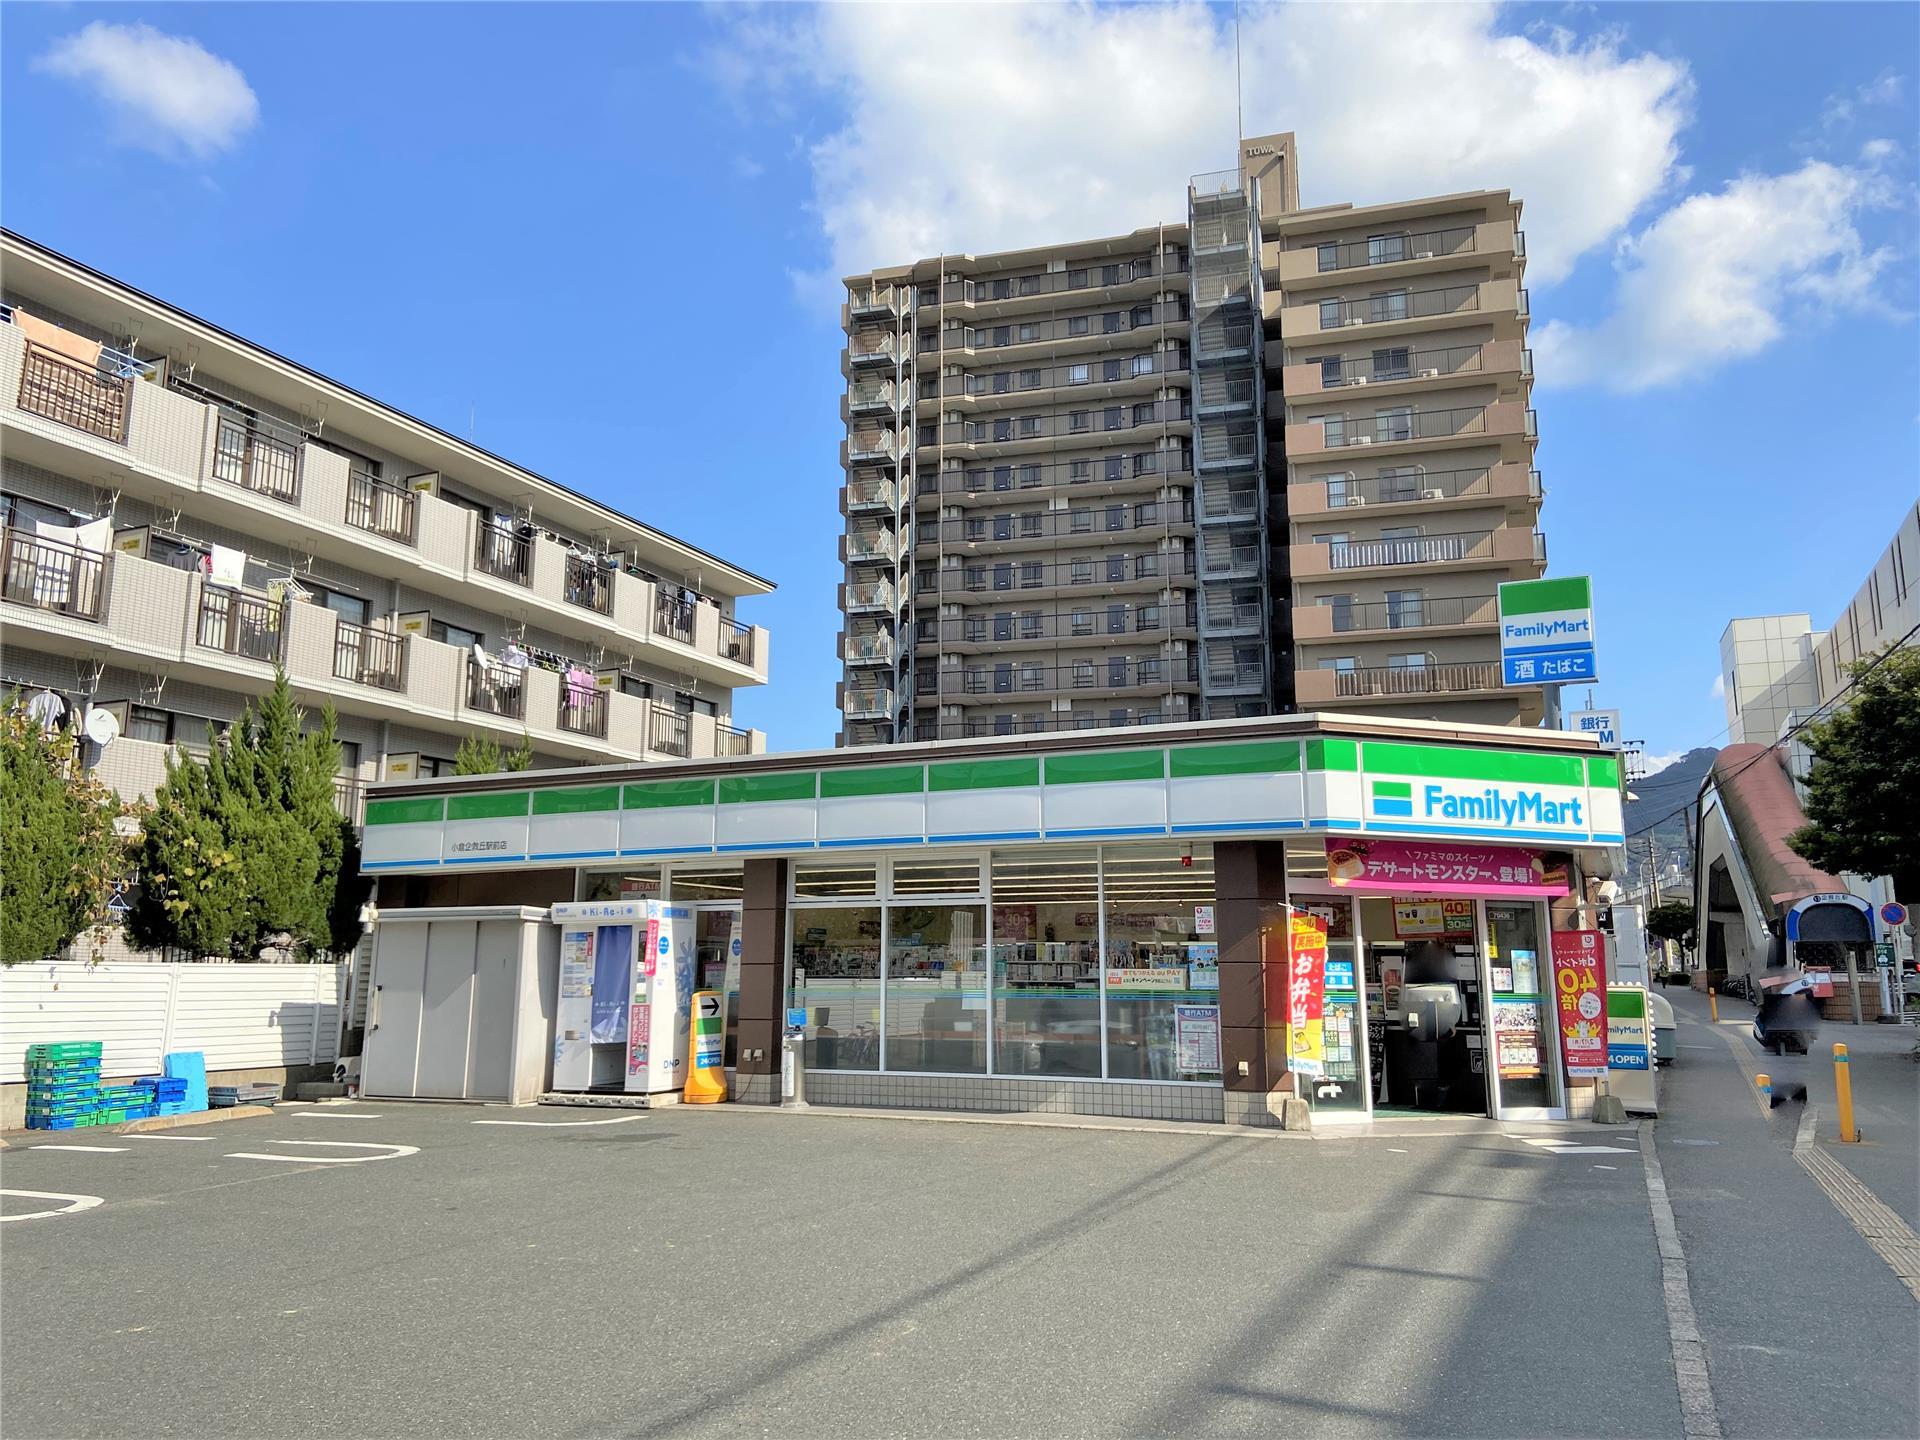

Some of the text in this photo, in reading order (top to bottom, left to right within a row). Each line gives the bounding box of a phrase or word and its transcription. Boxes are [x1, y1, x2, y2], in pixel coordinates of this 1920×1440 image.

[1247, 143, 1275, 157] TOWA
[1505, 619, 1589, 638] FamilyMart
[1514, 658, 1586, 679] 酒 たばこ
[1580, 716, 1610, 731] 銀行
[1424, 784, 1582, 826] FamilyMart
[1414, 851, 1486, 862] ファミマのスイーツ
[1290, 952, 1314, 1029] お弁当
[1607, 1025, 1643, 1035] milyMart
[663, 1059, 680, 1069] DNP
[1615, 1056, 1643, 1064] OPEN
